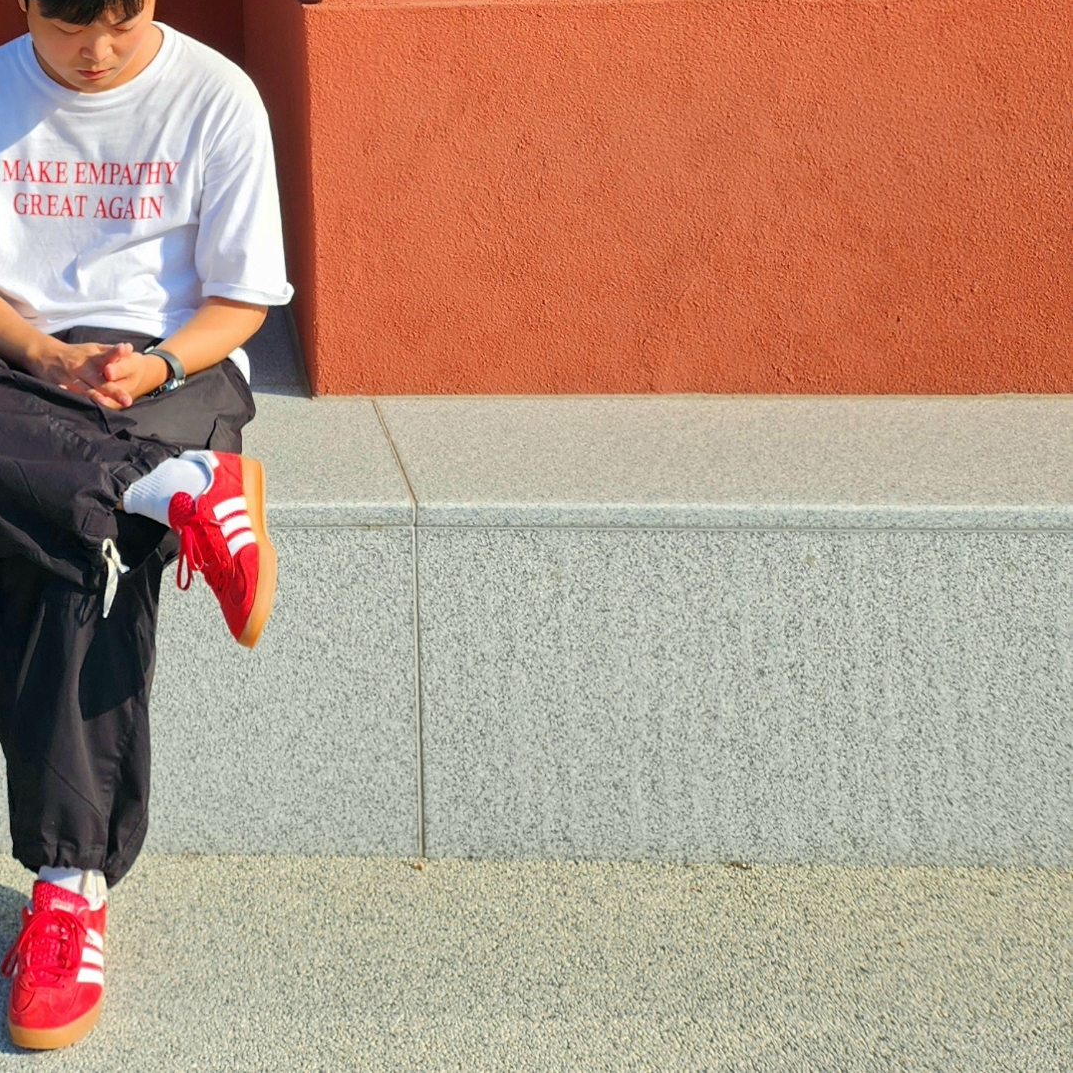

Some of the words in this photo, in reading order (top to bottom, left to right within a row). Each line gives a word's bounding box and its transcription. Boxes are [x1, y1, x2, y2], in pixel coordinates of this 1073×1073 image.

[2, 159, 68, 184] MAKE
[73, 161, 180, 186] EMPATHY
[13, 192, 88, 218] GREAT
[93, 195, 164, 220] AGAIN
